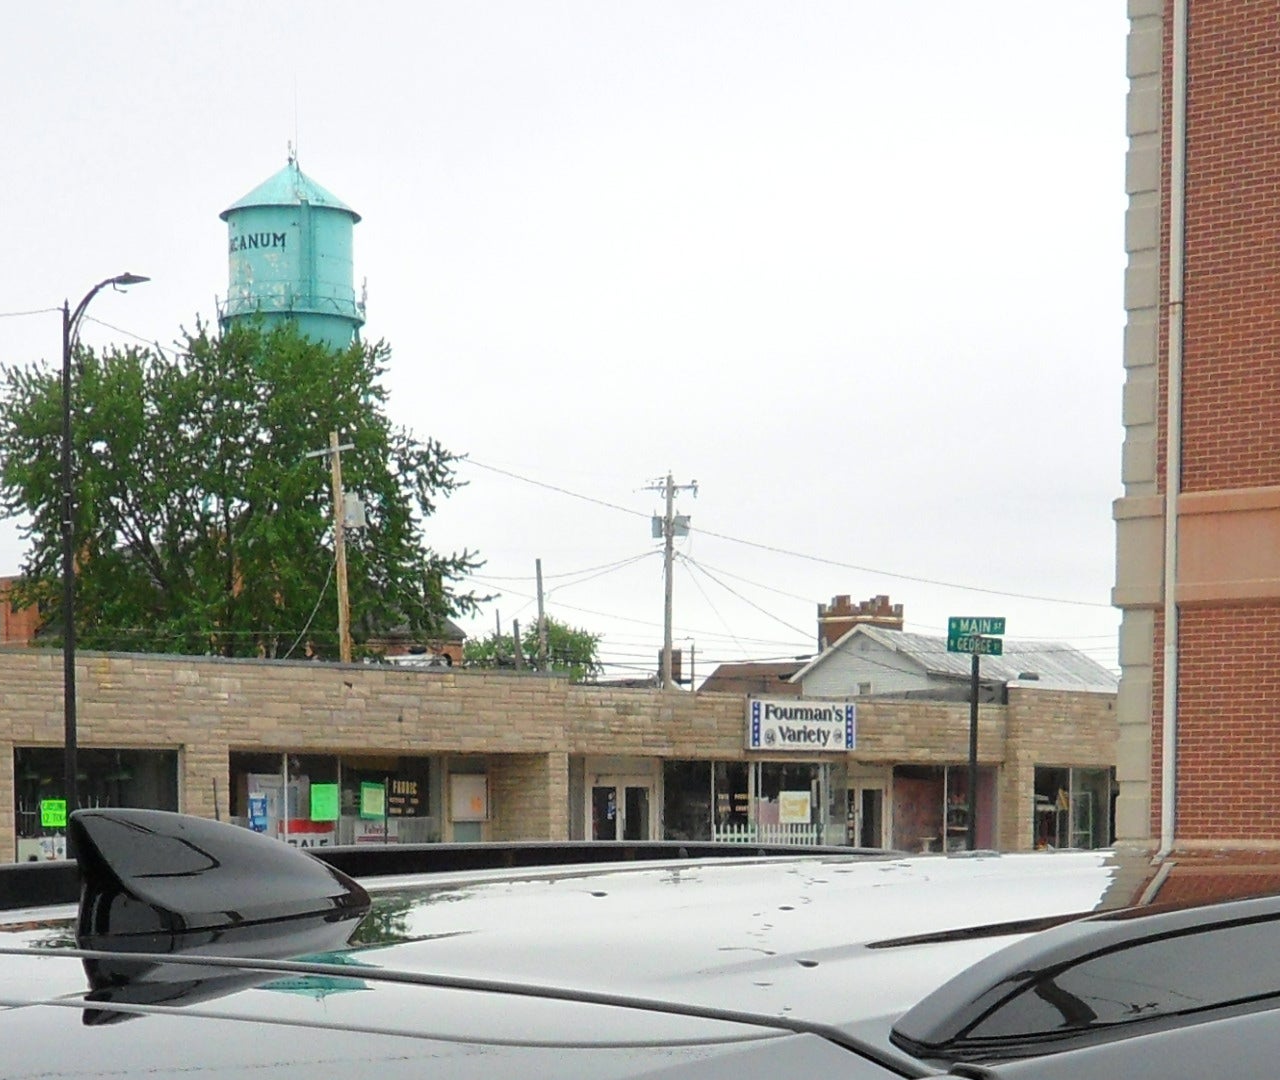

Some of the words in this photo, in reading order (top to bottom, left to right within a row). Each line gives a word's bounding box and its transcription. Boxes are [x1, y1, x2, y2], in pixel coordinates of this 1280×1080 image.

[229, 232, 286, 253] CANUM
[960, 619, 991, 633] MAIN
[957, 637, 992, 653] GEORGE
[765, 703, 844, 723] Fourman's
[778, 724, 831, 747] Variety
